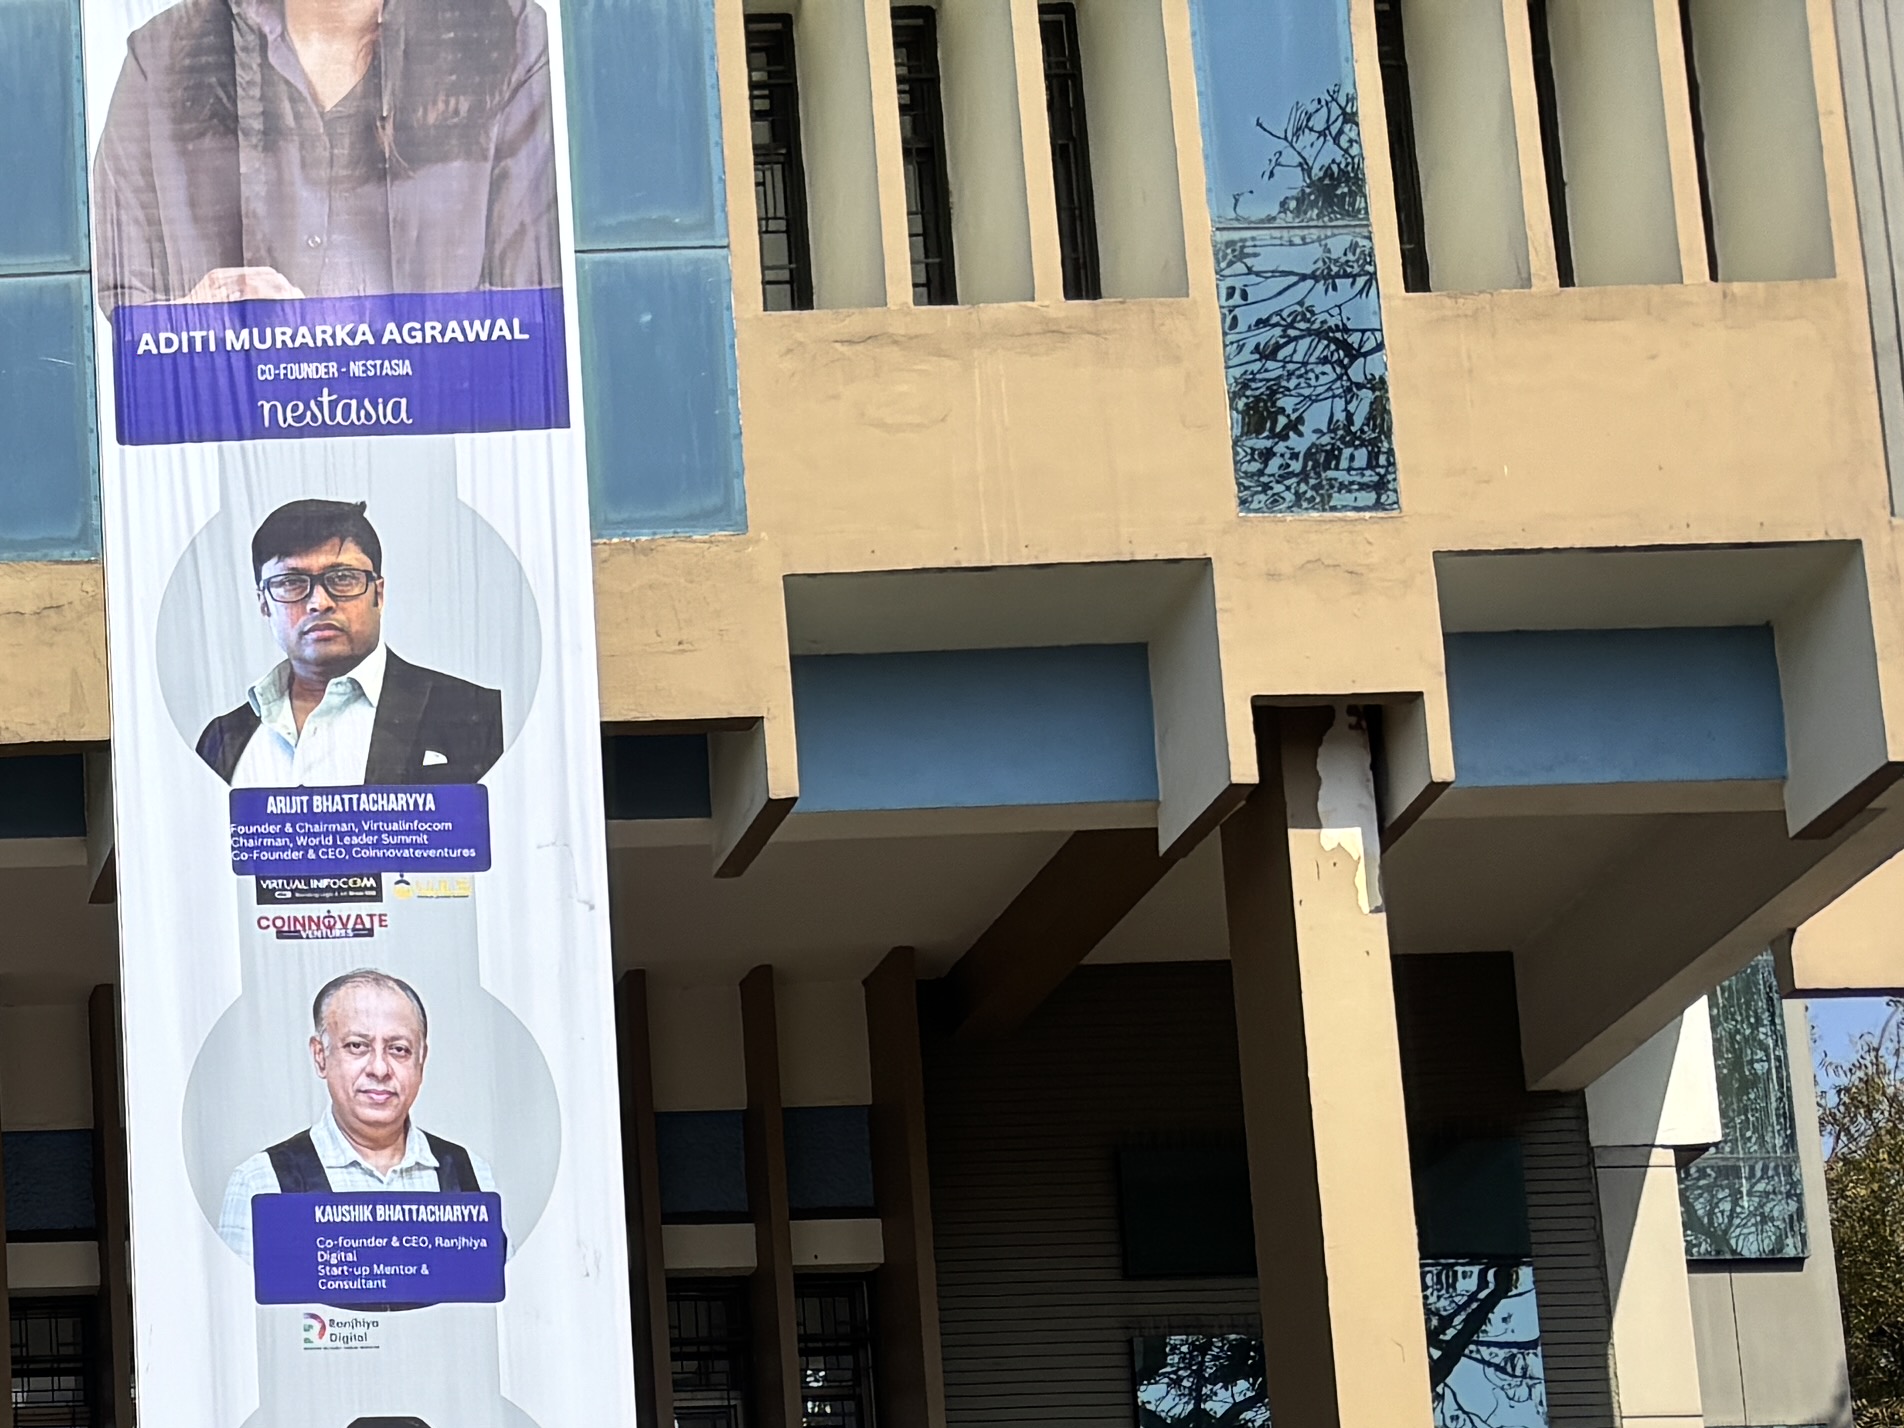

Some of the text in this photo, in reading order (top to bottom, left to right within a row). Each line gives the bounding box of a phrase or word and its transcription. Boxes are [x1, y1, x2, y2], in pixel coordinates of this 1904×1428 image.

[136, 317, 530, 355] ADITI MURARKA AGRAWAL
[257, 361, 338, 381] CO-FOUNDER
[349, 358, 412, 377] NESTASIA
[257, 386, 413, 428] nestasia
[266, 793, 436, 814] ARIJIT BHATTACHARYYA
[231, 822, 281, 834] Founder
[284, 822, 292, 833] &
[295, 821, 358, 835] Chairman,
[231, 832, 429, 849] Chairman, World Leader Summit
[231, 849, 304, 861] Co-Founder
[307, 848, 316, 860] &
[318, 848, 349, 861] CEO,
[259, 877, 308, 890] VIRTUAL
[256, 912, 389, 931] COINNOVATE
[314, 1203, 489, 1223] KAUSHIK BHATTACHARYYA
[316, 1235, 488, 1250] Co-founder & CEO, Ranjhiya
[317, 1250, 358, 1265] Digital
[318, 1263, 429, 1278] Start-up Mentor &
[318, 1277, 387, 1290] Consultant
